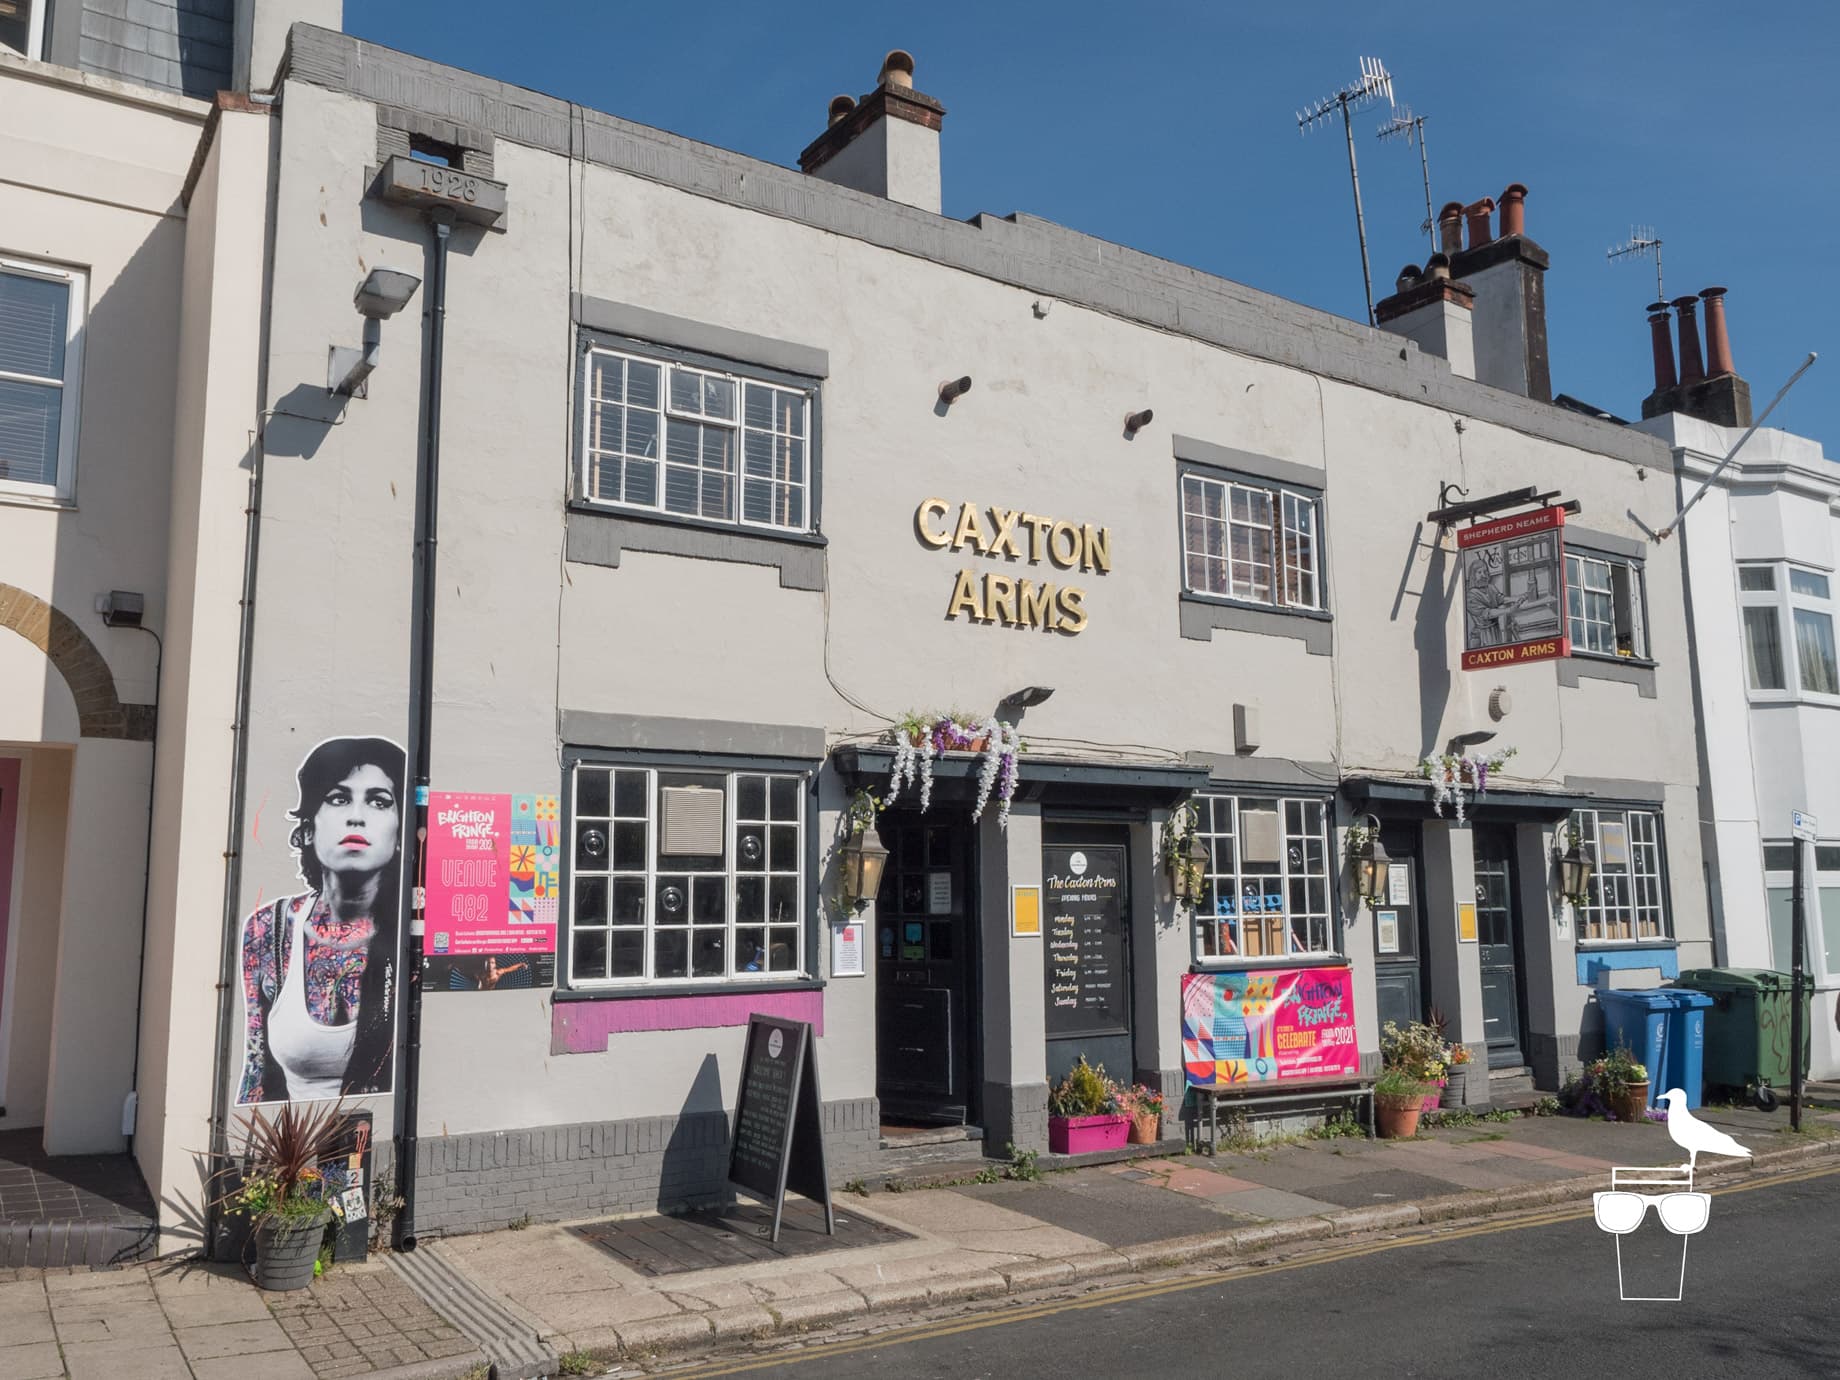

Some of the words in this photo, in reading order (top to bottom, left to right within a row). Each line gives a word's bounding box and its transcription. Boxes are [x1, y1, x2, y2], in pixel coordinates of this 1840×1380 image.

[421, 168, 479, 202] 1928
[915, 496, 1112, 574] CAXTON
[1463, 523, 1513, 542] SHEPHERD
[1516, 515, 1551, 529] NEAME
[946, 568, 1090, 635] ARMS
[1468, 648, 1514, 665] CAXTON
[1521, 642, 1556, 659] ARMS
[437, 808, 495, 825] BRIGHTON
[441, 859, 497, 888] VENUE
[1047, 874, 1064, 889] The
[1065, 875, 1094, 889] Caxton
[451, 894, 489, 922] 482
[1055, 968, 1077, 981] Friday
[1051, 982, 1079, 994] Saturday
[1054, 996, 1077, 1009] Sunday
[1277, 1031, 1317, 1050] CELEBRATE
[350, 1171, 359, 1185] 2
